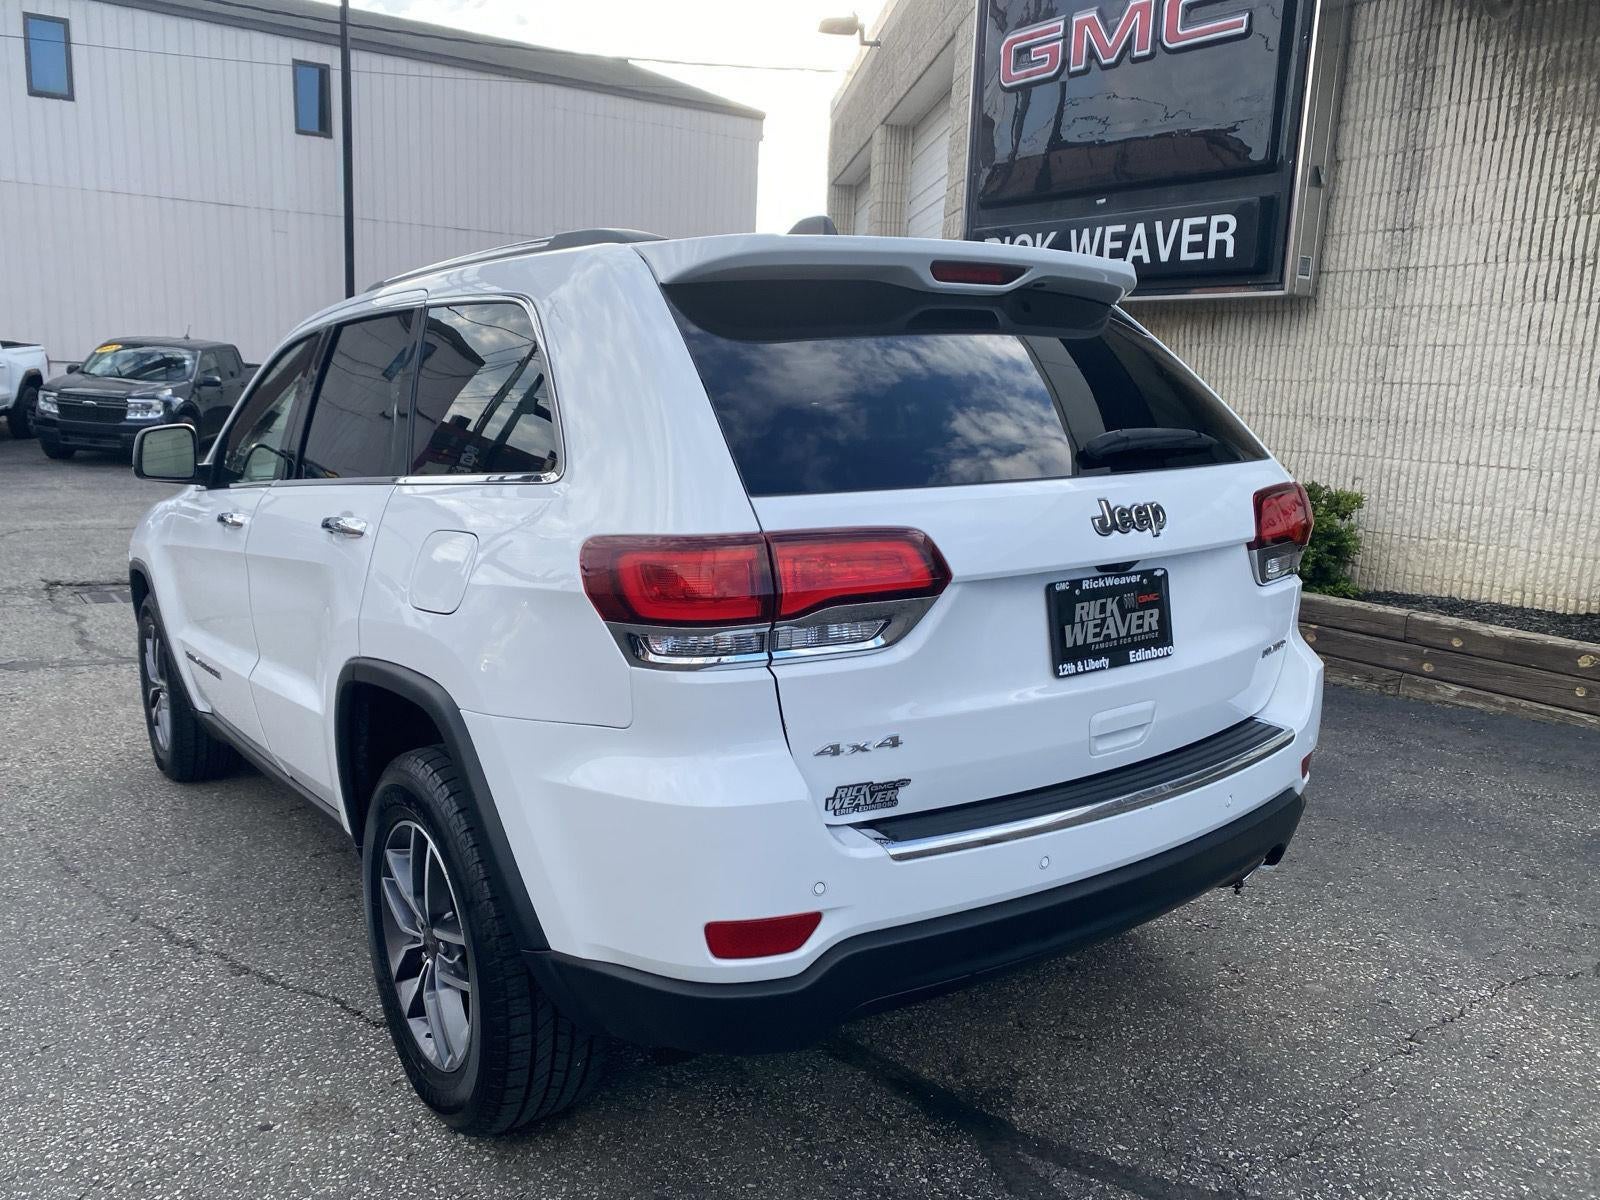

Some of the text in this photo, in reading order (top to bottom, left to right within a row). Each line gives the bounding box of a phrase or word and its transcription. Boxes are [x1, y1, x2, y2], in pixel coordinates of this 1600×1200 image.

[1000, 0, 1251, 88] GMC
[1070, 214, 1238, 263] WEAVER
[1091, 498, 1167, 537] Jeep
[1055, 582, 1070, 591] GMC
[1082, 574, 1141, 590] RickWeaver
[1075, 597, 1120, 623] RICK
[1064, 608, 1160, 648] WEAVER
[1129, 645, 1174, 663] Edinboro
[1058, 656, 1110, 676] 12th & Liberty
[828, 789, 899, 811] WEAVER
[836, 784, 873, 799] RICK
